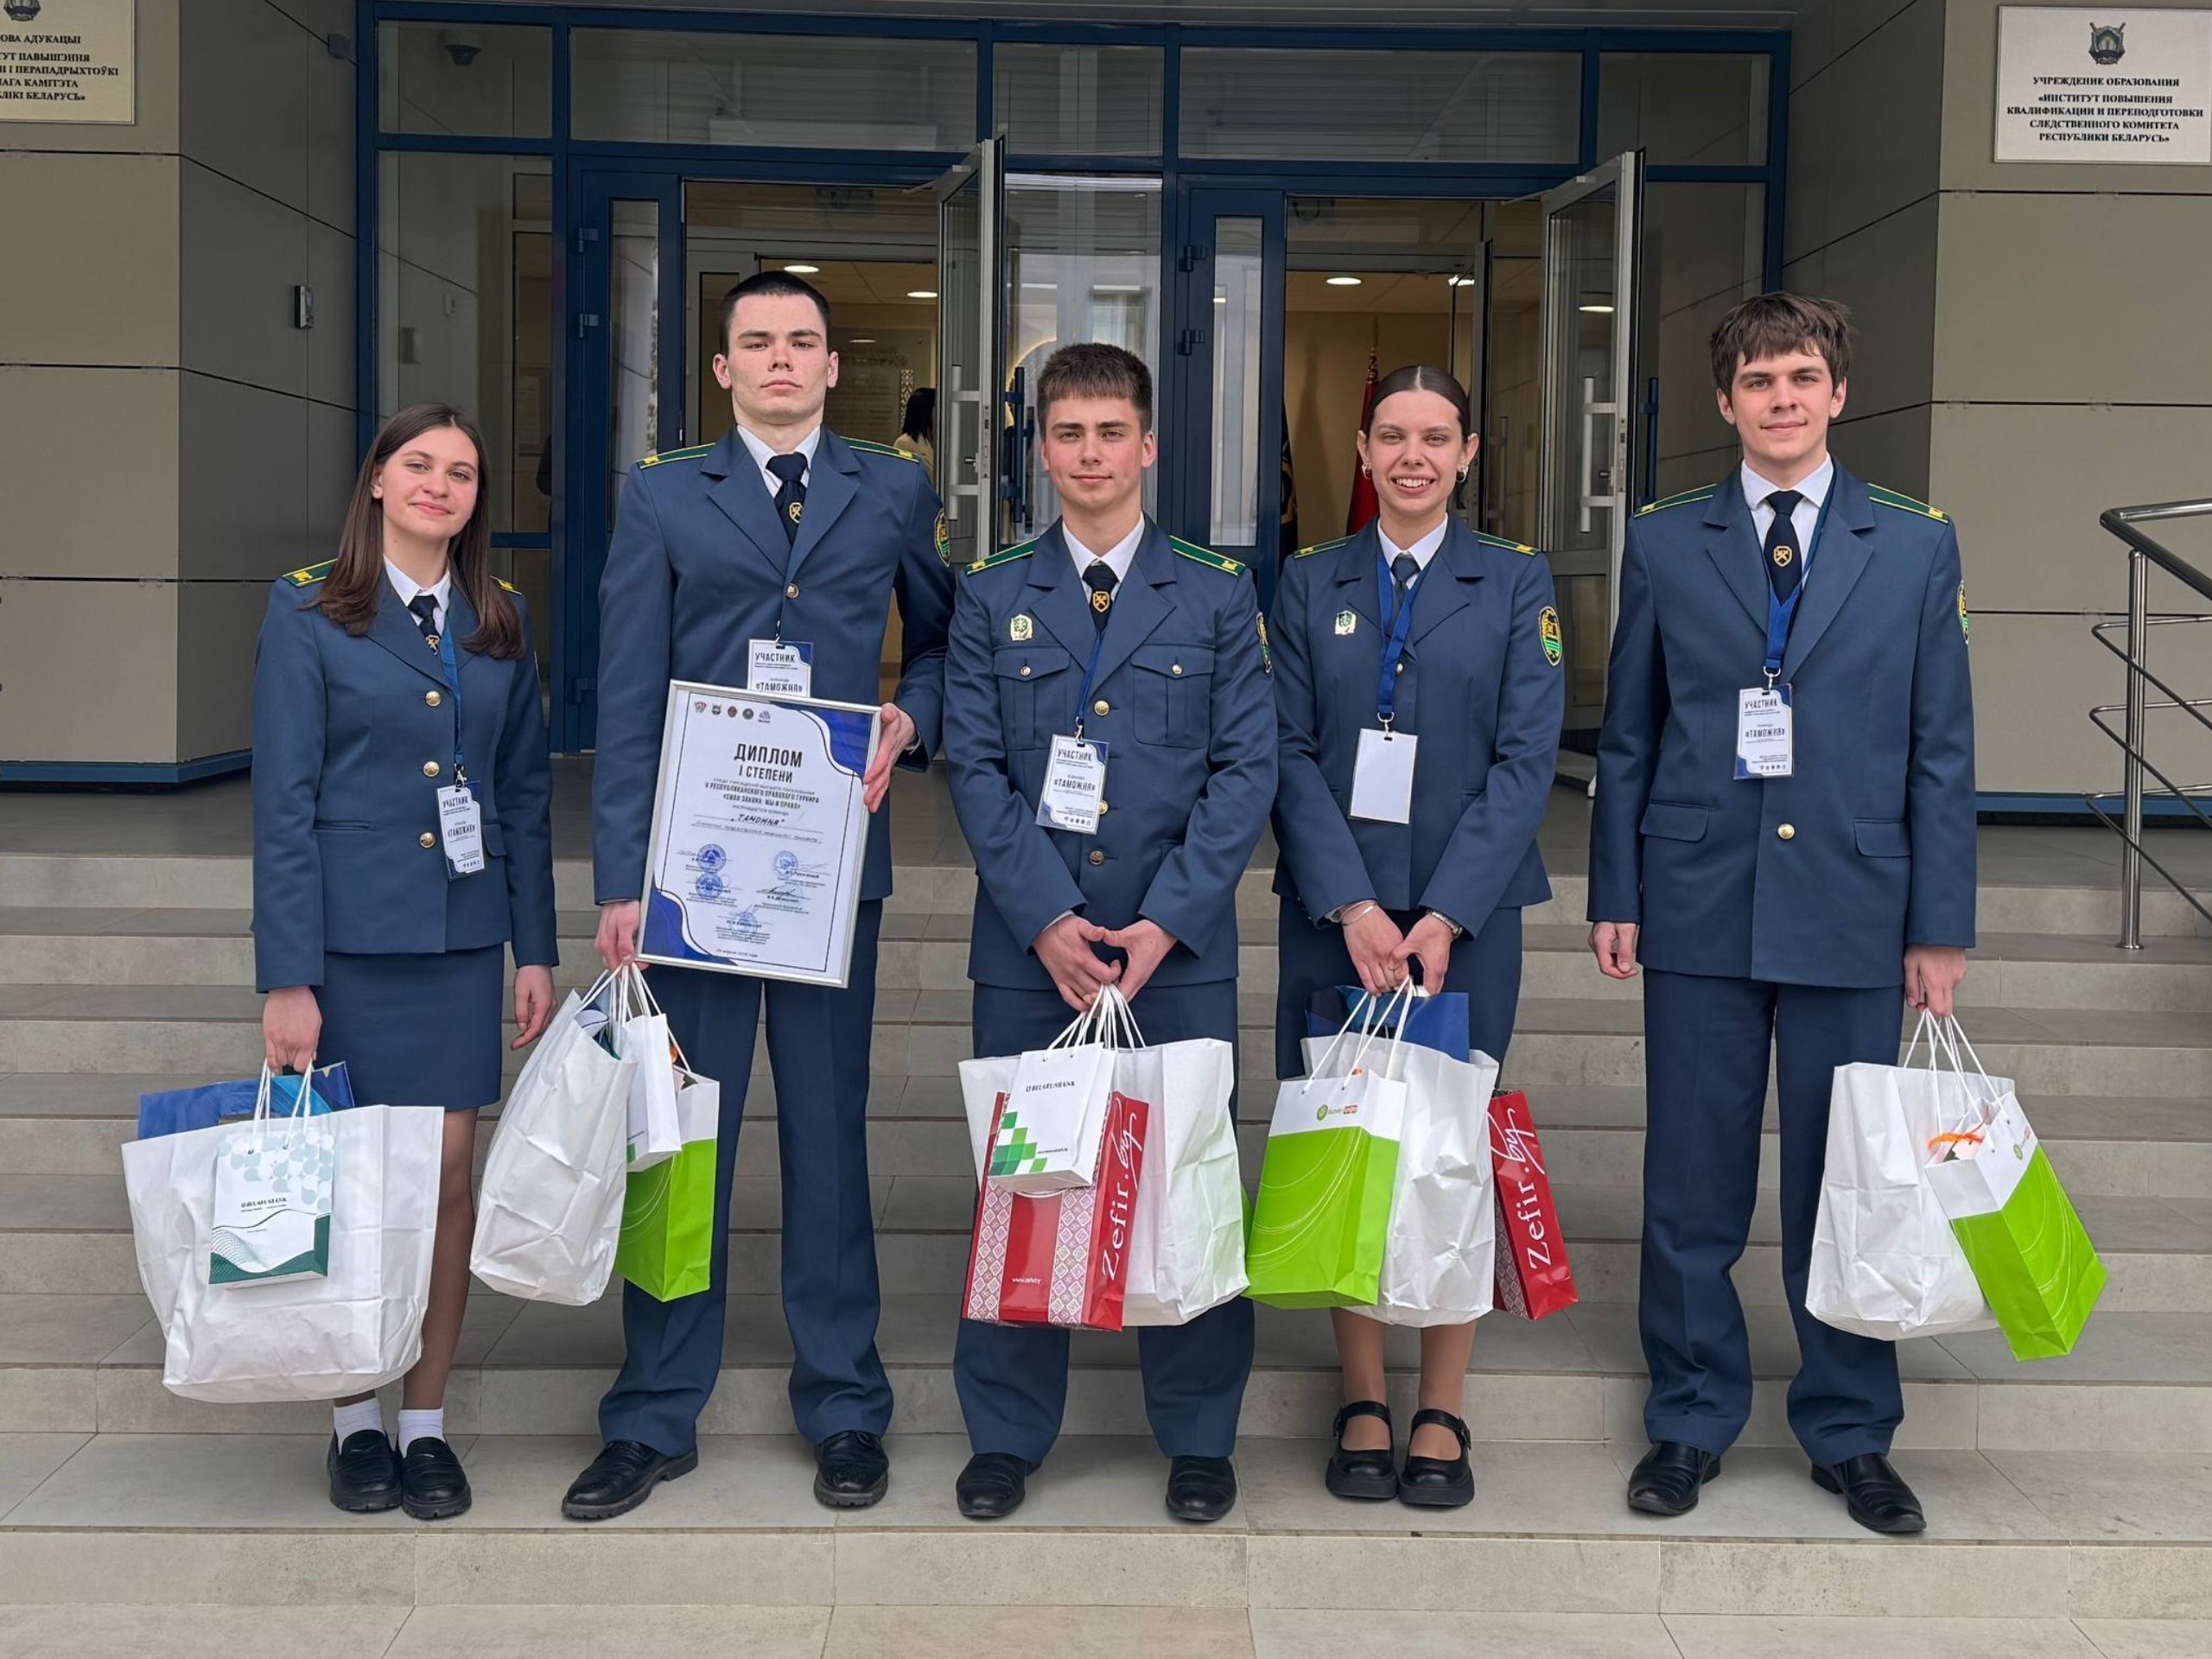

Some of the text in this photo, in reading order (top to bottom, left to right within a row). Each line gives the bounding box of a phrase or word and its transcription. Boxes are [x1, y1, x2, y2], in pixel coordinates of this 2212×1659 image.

[19, 53, 90, 62] ПАВЫШЭННЯ
[24, 79, 79, 88] КАМІТЭТА
[2032, 76, 2179, 86] УЧРЕЖДЕНИЕ ОБРАЗОВАНИЯ
[2038, 94, 2173, 104] «ИНСТИТУТ ПОВЫШЕНИЯ
[2006, 107, 2203, 118] КВАЛИФИКАЦИИ И ПЕРЕПОДГОТОВКИ
[2030, 120, 2179, 130] СЛЕДСТВЕННОГО КОМИТЕТА
[2039, 133, 2170, 143] РЕСПУБЛИКИ БЕЛАРУСЬ»
[754, 652, 796, 664] УЧАСТНИК
[734, 743, 803, 768] ДИПЛОМ
[1057, 749, 1092, 762] УЧАСТНИК
[746, 766, 793, 784] СТЕПЕНИ
